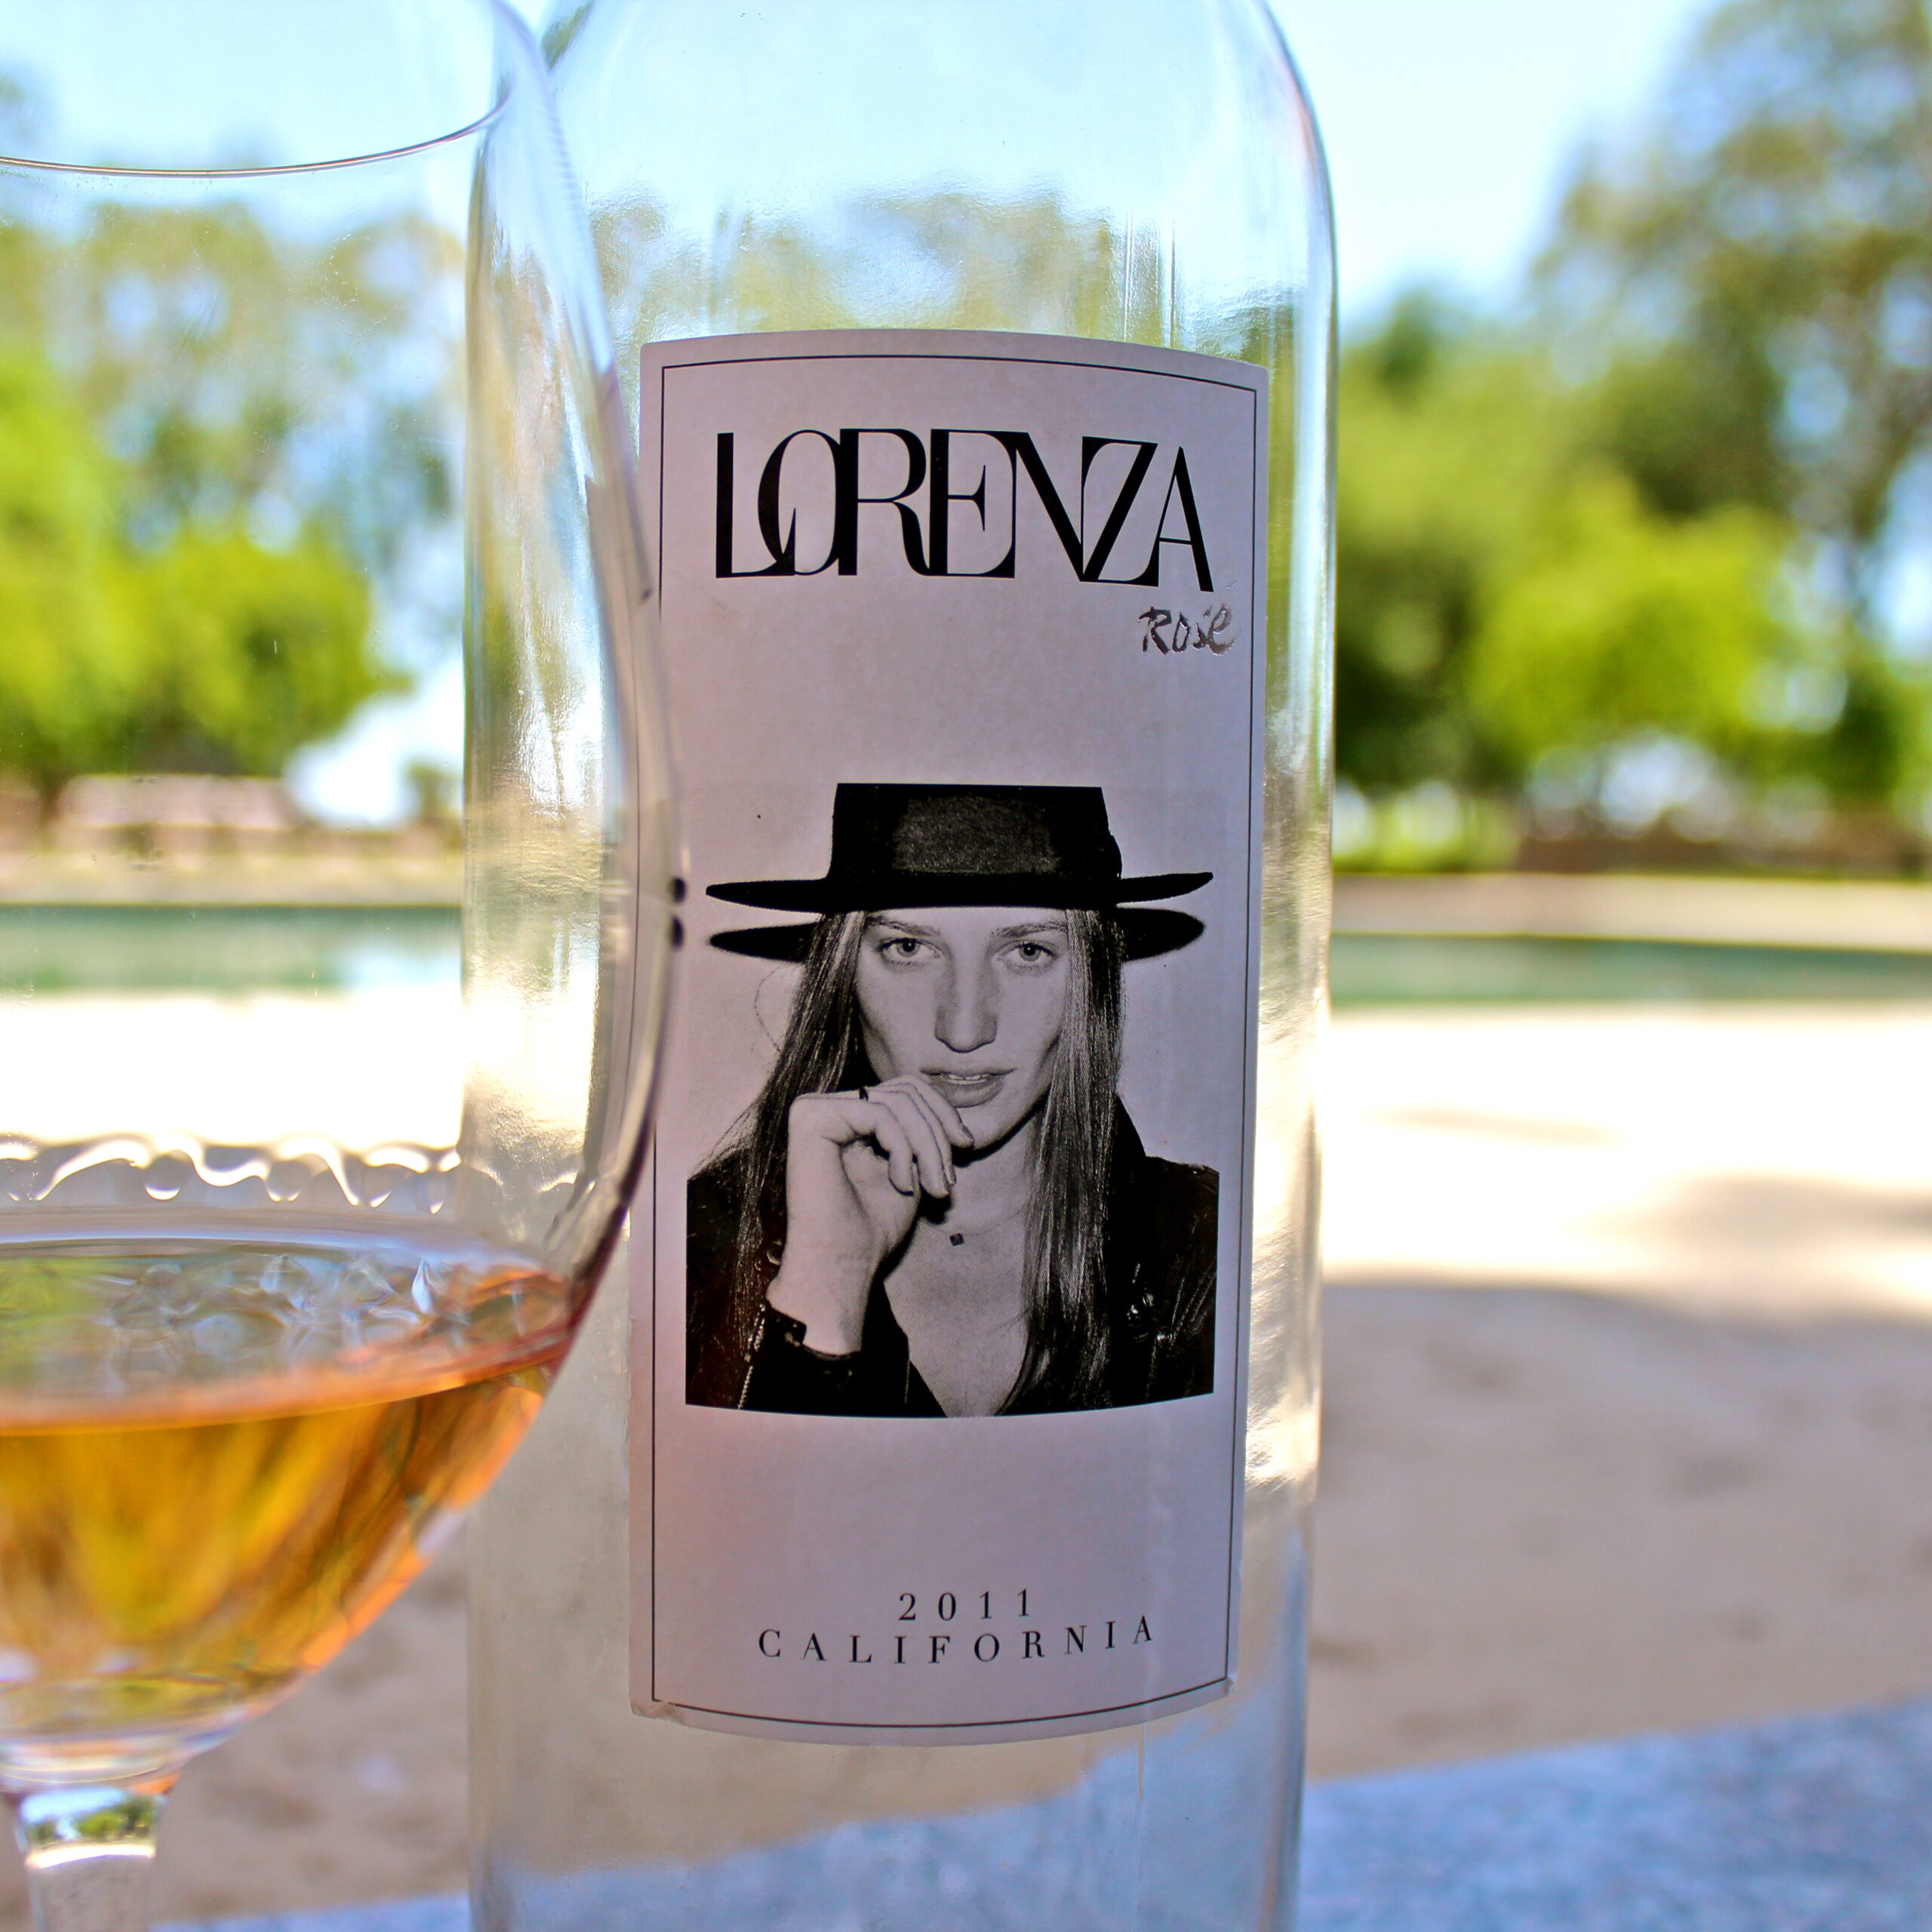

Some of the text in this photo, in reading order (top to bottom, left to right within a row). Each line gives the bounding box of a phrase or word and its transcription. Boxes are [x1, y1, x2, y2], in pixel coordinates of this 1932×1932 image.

[715, 428, 1214, 592] LORENZA
[897, 1589, 1031, 1622] 2011
[758, 1615, 1153, 1664] CALIFORNIA
